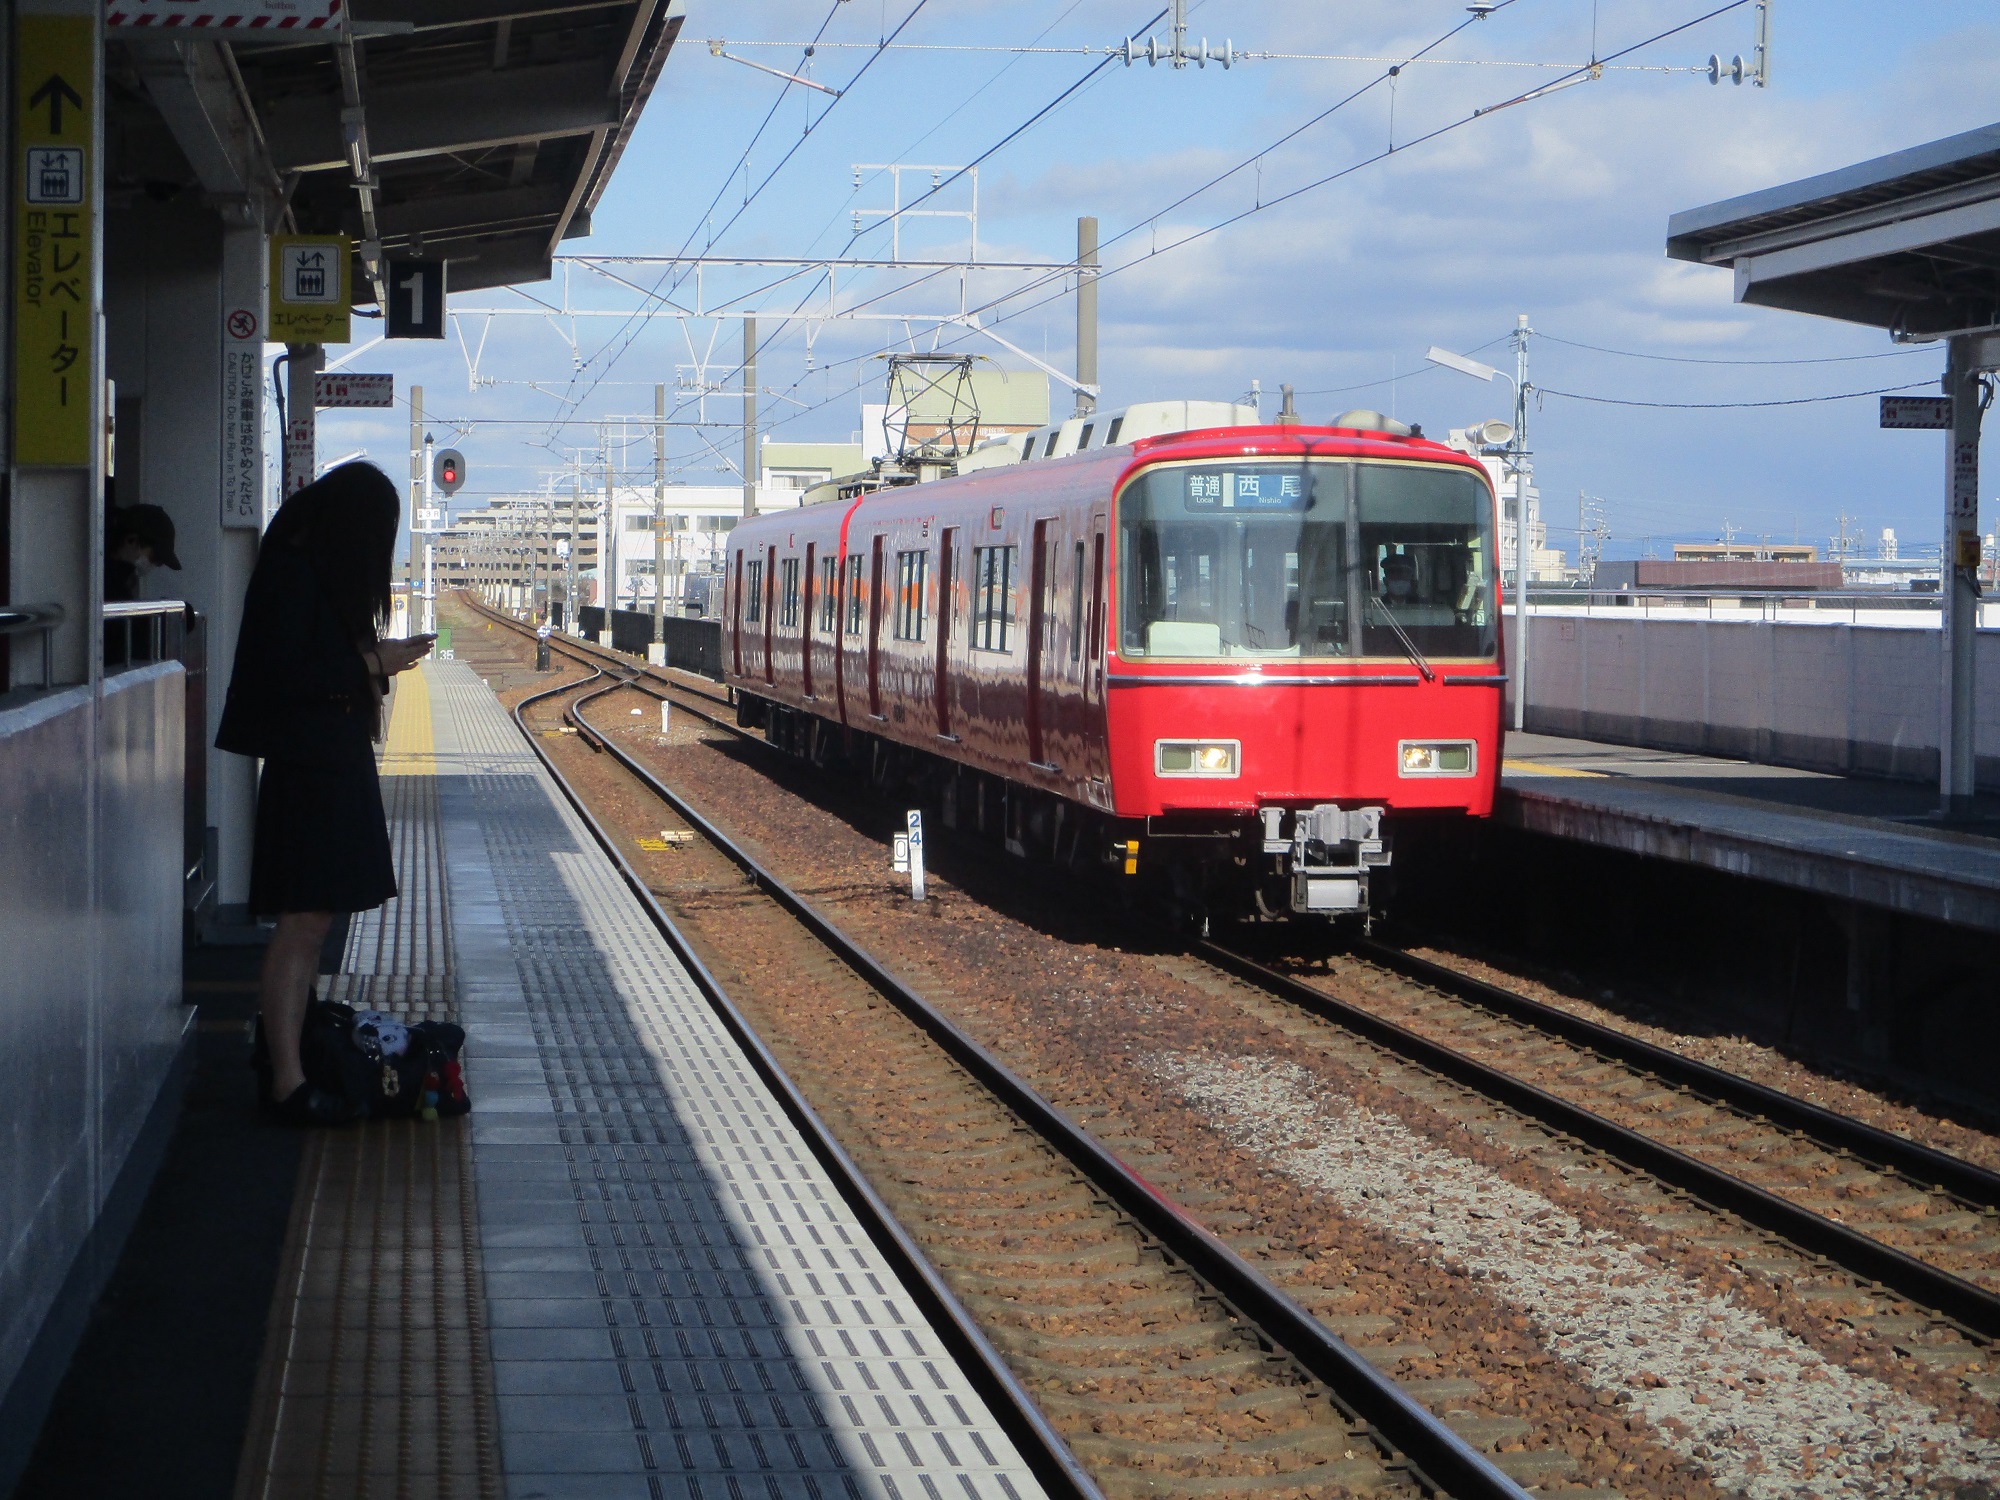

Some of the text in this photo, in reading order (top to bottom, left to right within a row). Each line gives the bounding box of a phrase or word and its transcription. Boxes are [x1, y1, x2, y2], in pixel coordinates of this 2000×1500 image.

[26, 211, 47, 308] Elevator
[400, 271, 424, 325] 1
[50, 212, 81, 407] エレベーター
[274, 313, 346, 326] エレベーター
[1189, 474, 1221, 497] 普通
[1196, 496, 1214, 504] Local
[1258, 496, 1282, 504] Nishio
[440, 649, 454, 660] 35
